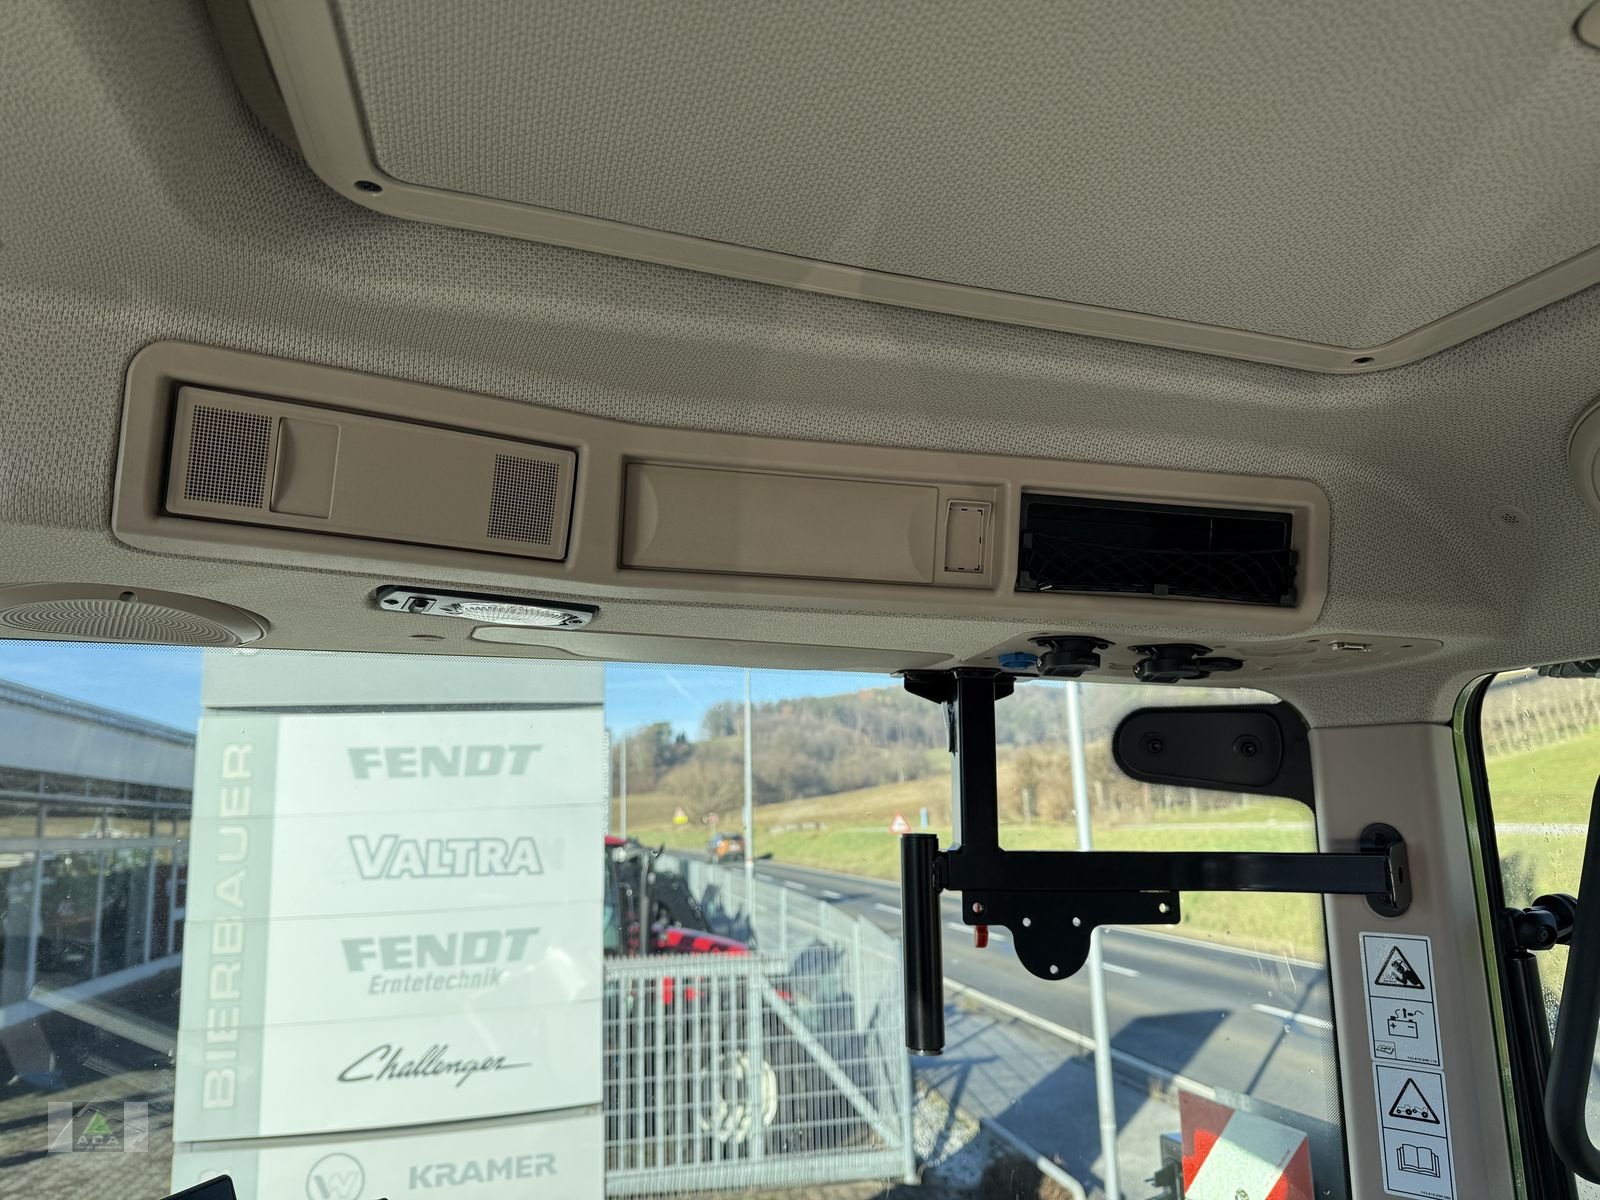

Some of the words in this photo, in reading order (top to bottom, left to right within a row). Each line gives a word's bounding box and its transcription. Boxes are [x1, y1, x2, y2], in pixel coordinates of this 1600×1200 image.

[347, 744, 543, 780] FENDT
[202, 741, 253, 1110] BIERBAUER
[340, 926, 541, 973] FENDT
[367, 966, 502, 996] Erntetechnik
[337, 1043, 533, 1089] Challenger
[407, 1152, 558, 1190] KRAMER
